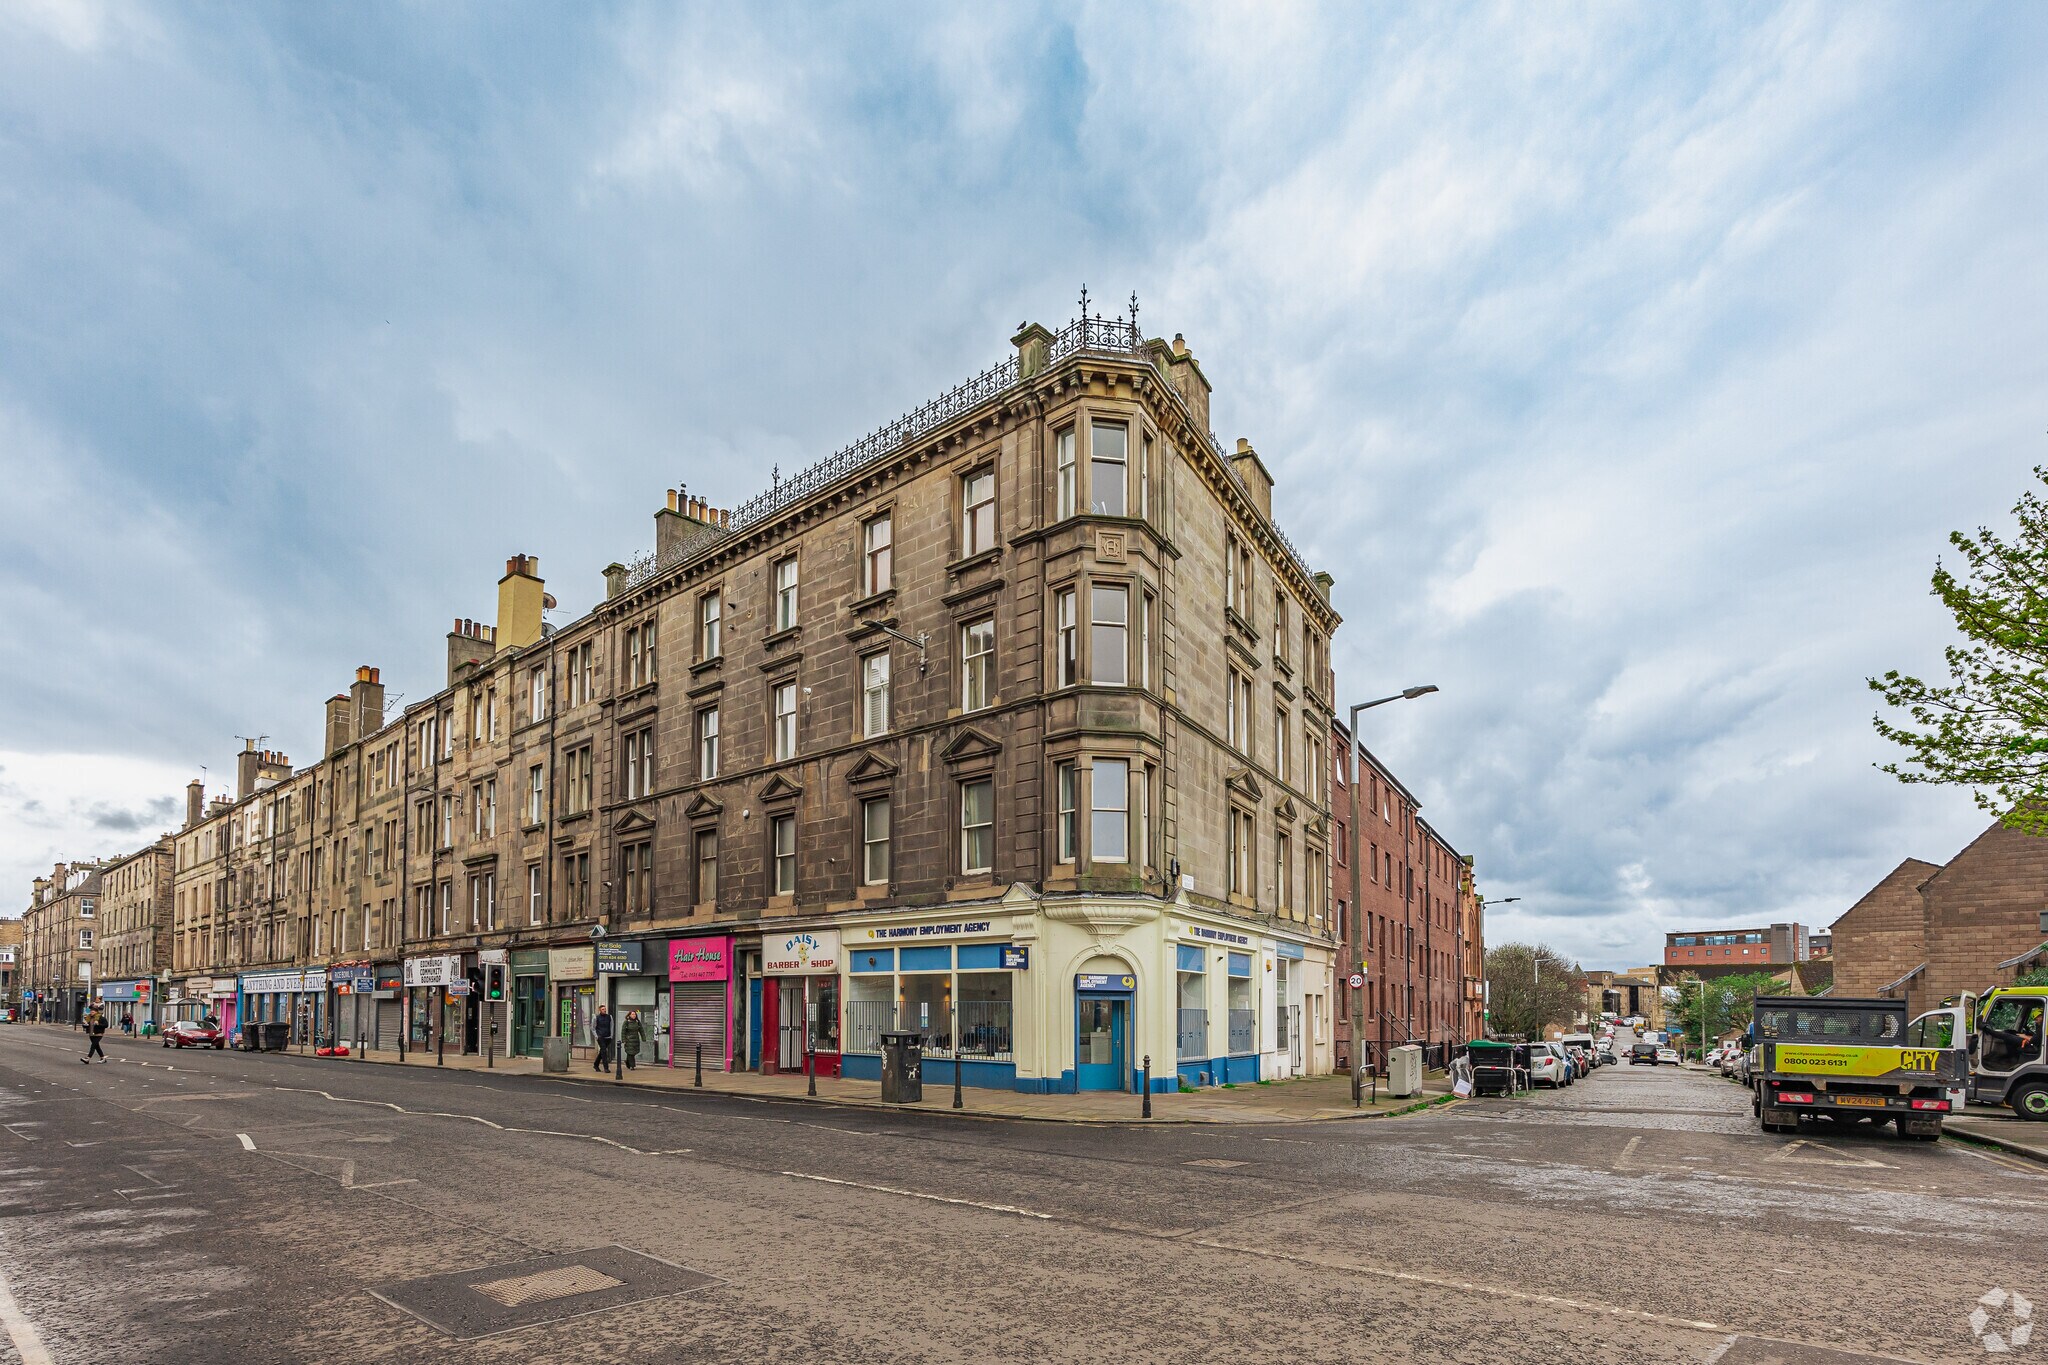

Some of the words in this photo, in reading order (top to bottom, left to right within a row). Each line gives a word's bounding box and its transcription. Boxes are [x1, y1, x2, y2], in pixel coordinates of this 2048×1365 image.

[876, 929, 887, 938] THE
[888, 927, 917, 938] HARMONY
[919, 923, 962, 936] EMPLOYMENT
[963, 921, 990, 933] AGENCY
[785, 934, 820, 952] DAISY
[674, 949, 695, 963] Hair
[695, 947, 721, 962] House
[420, 959, 442, 968] EDINBURGH
[598, 962, 614, 971] DM
[615, 962, 640, 971] HALL
[767, 961, 800, 969] BARBER
[810, 960, 833, 968] SHOP
[420, 967, 442, 976] COMMUNITY
[421, 975, 441, 983] BOOKSHOP
[1350, 977, 1362, 985] 20
[245, 980, 272, 991] ANYTHING
[273, 979, 285, 990] AND
[1809, 1058, 1826, 1066] 023
[1900, 1050, 1940, 1071] CITY
[1840, 1096, 1862, 1105] WV24
[1864, 1097, 1881, 1105] ZNE
